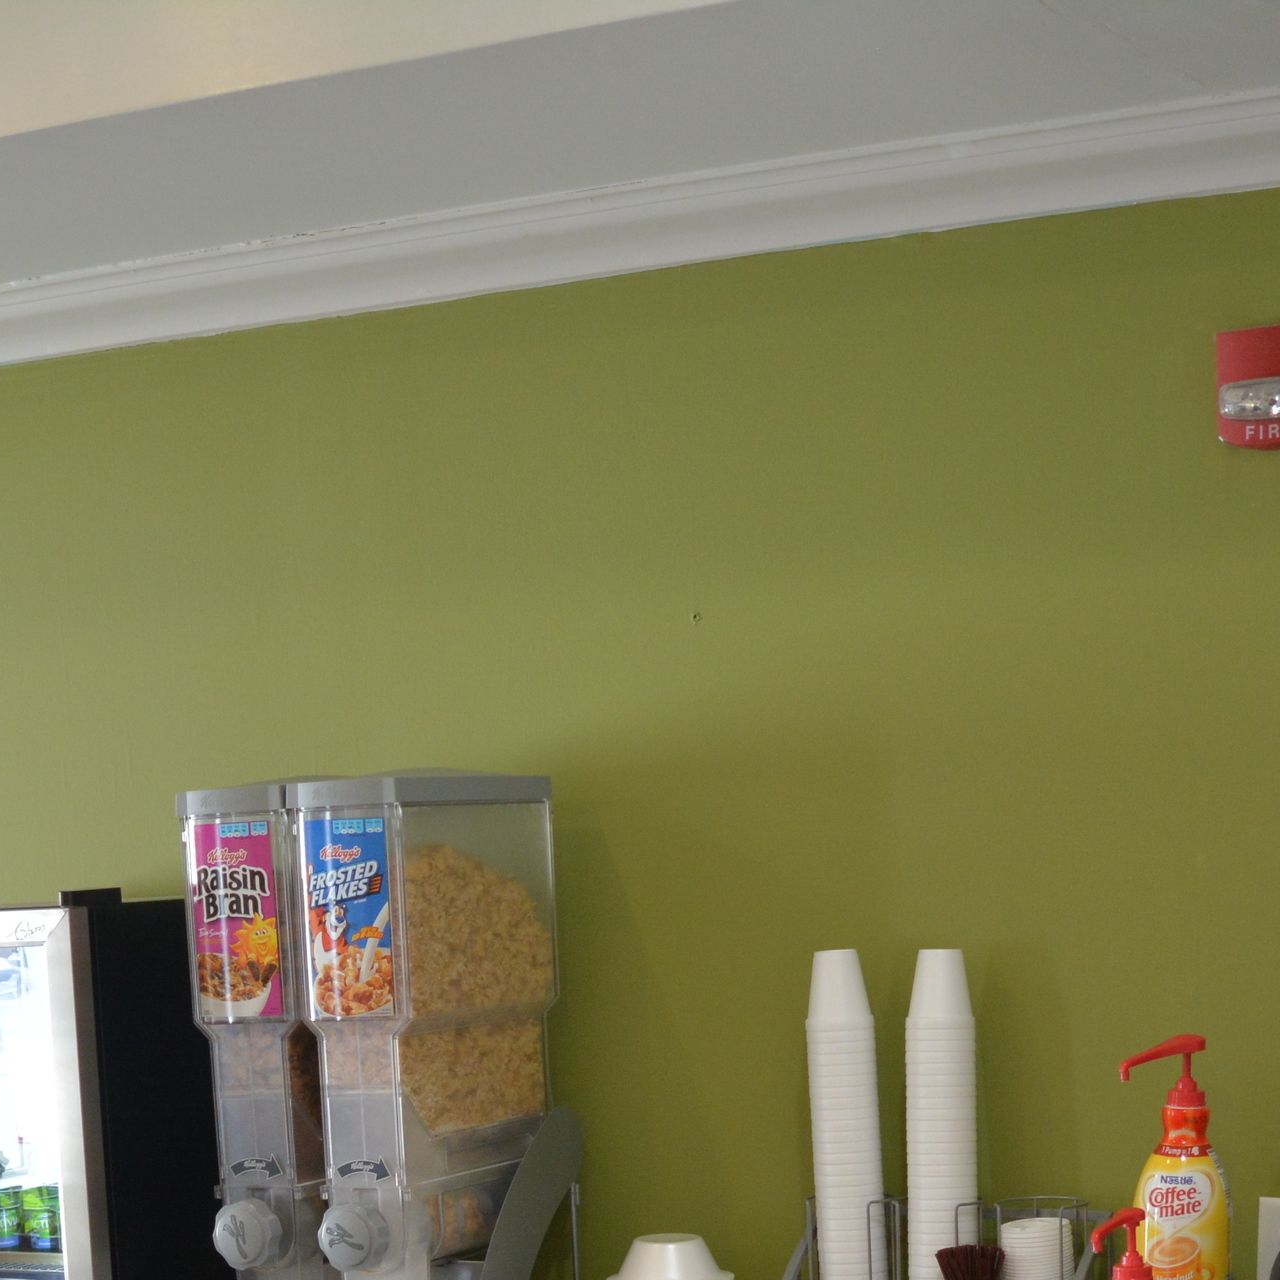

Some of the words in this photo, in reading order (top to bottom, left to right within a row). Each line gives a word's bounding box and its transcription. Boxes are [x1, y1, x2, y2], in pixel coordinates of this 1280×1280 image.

[207, 847, 247, 865] Kellogg's
[320, 844, 362, 863] Kellogg's
[195, 866, 268, 898] Raisin
[308, 860, 378, 892] FROSTED
[311, 879, 369, 908] FLAKES
[204, 892, 262, 920] Bran
[1148, 1186, 1203, 1207] Coffee-
[1159, 1200, 1202, 1218] mate
